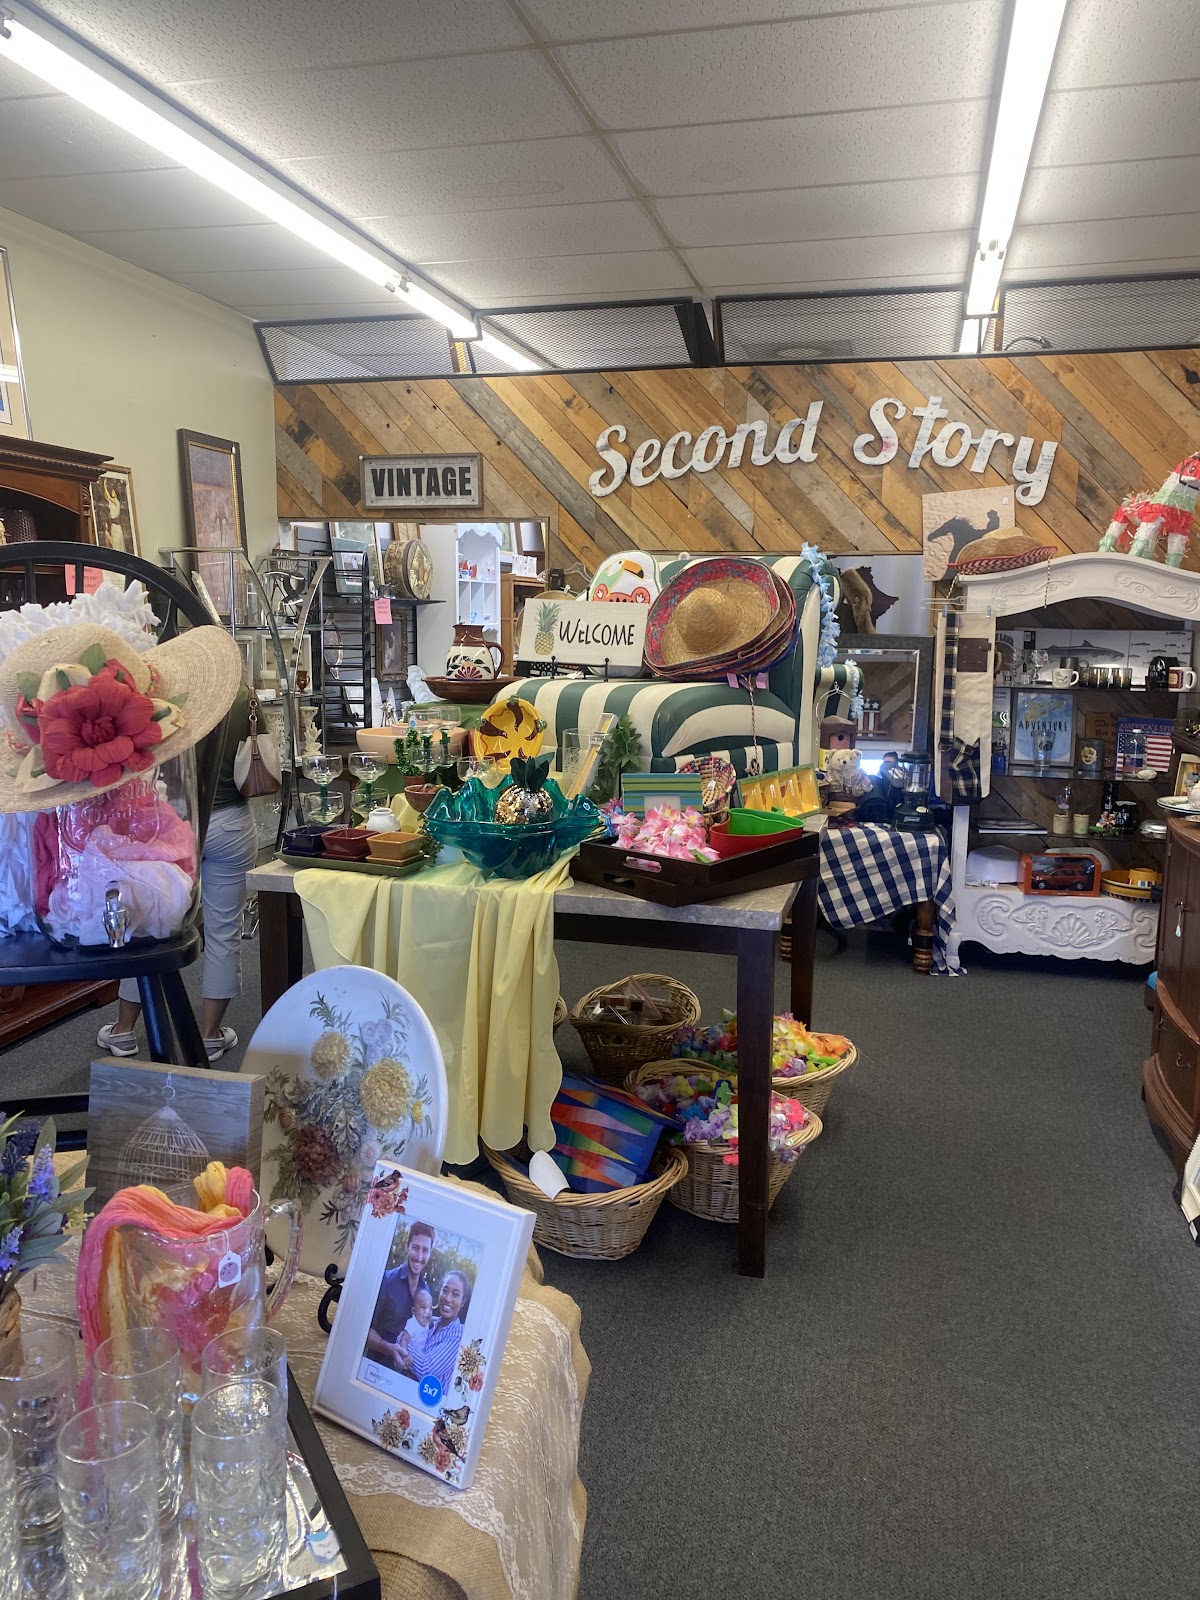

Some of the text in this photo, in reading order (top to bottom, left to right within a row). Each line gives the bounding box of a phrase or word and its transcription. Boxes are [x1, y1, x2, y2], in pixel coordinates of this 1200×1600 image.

[588, 395, 1058, 506] Second Story
[370, 466, 472, 497] VINTAGE
[559, 618, 636, 647] WELCOME
[1018, 720, 1068, 731] ADVENTURE
[1160, 724, 1175, 732] SPIR
[423, 1384, 438, 1397] 5x7
